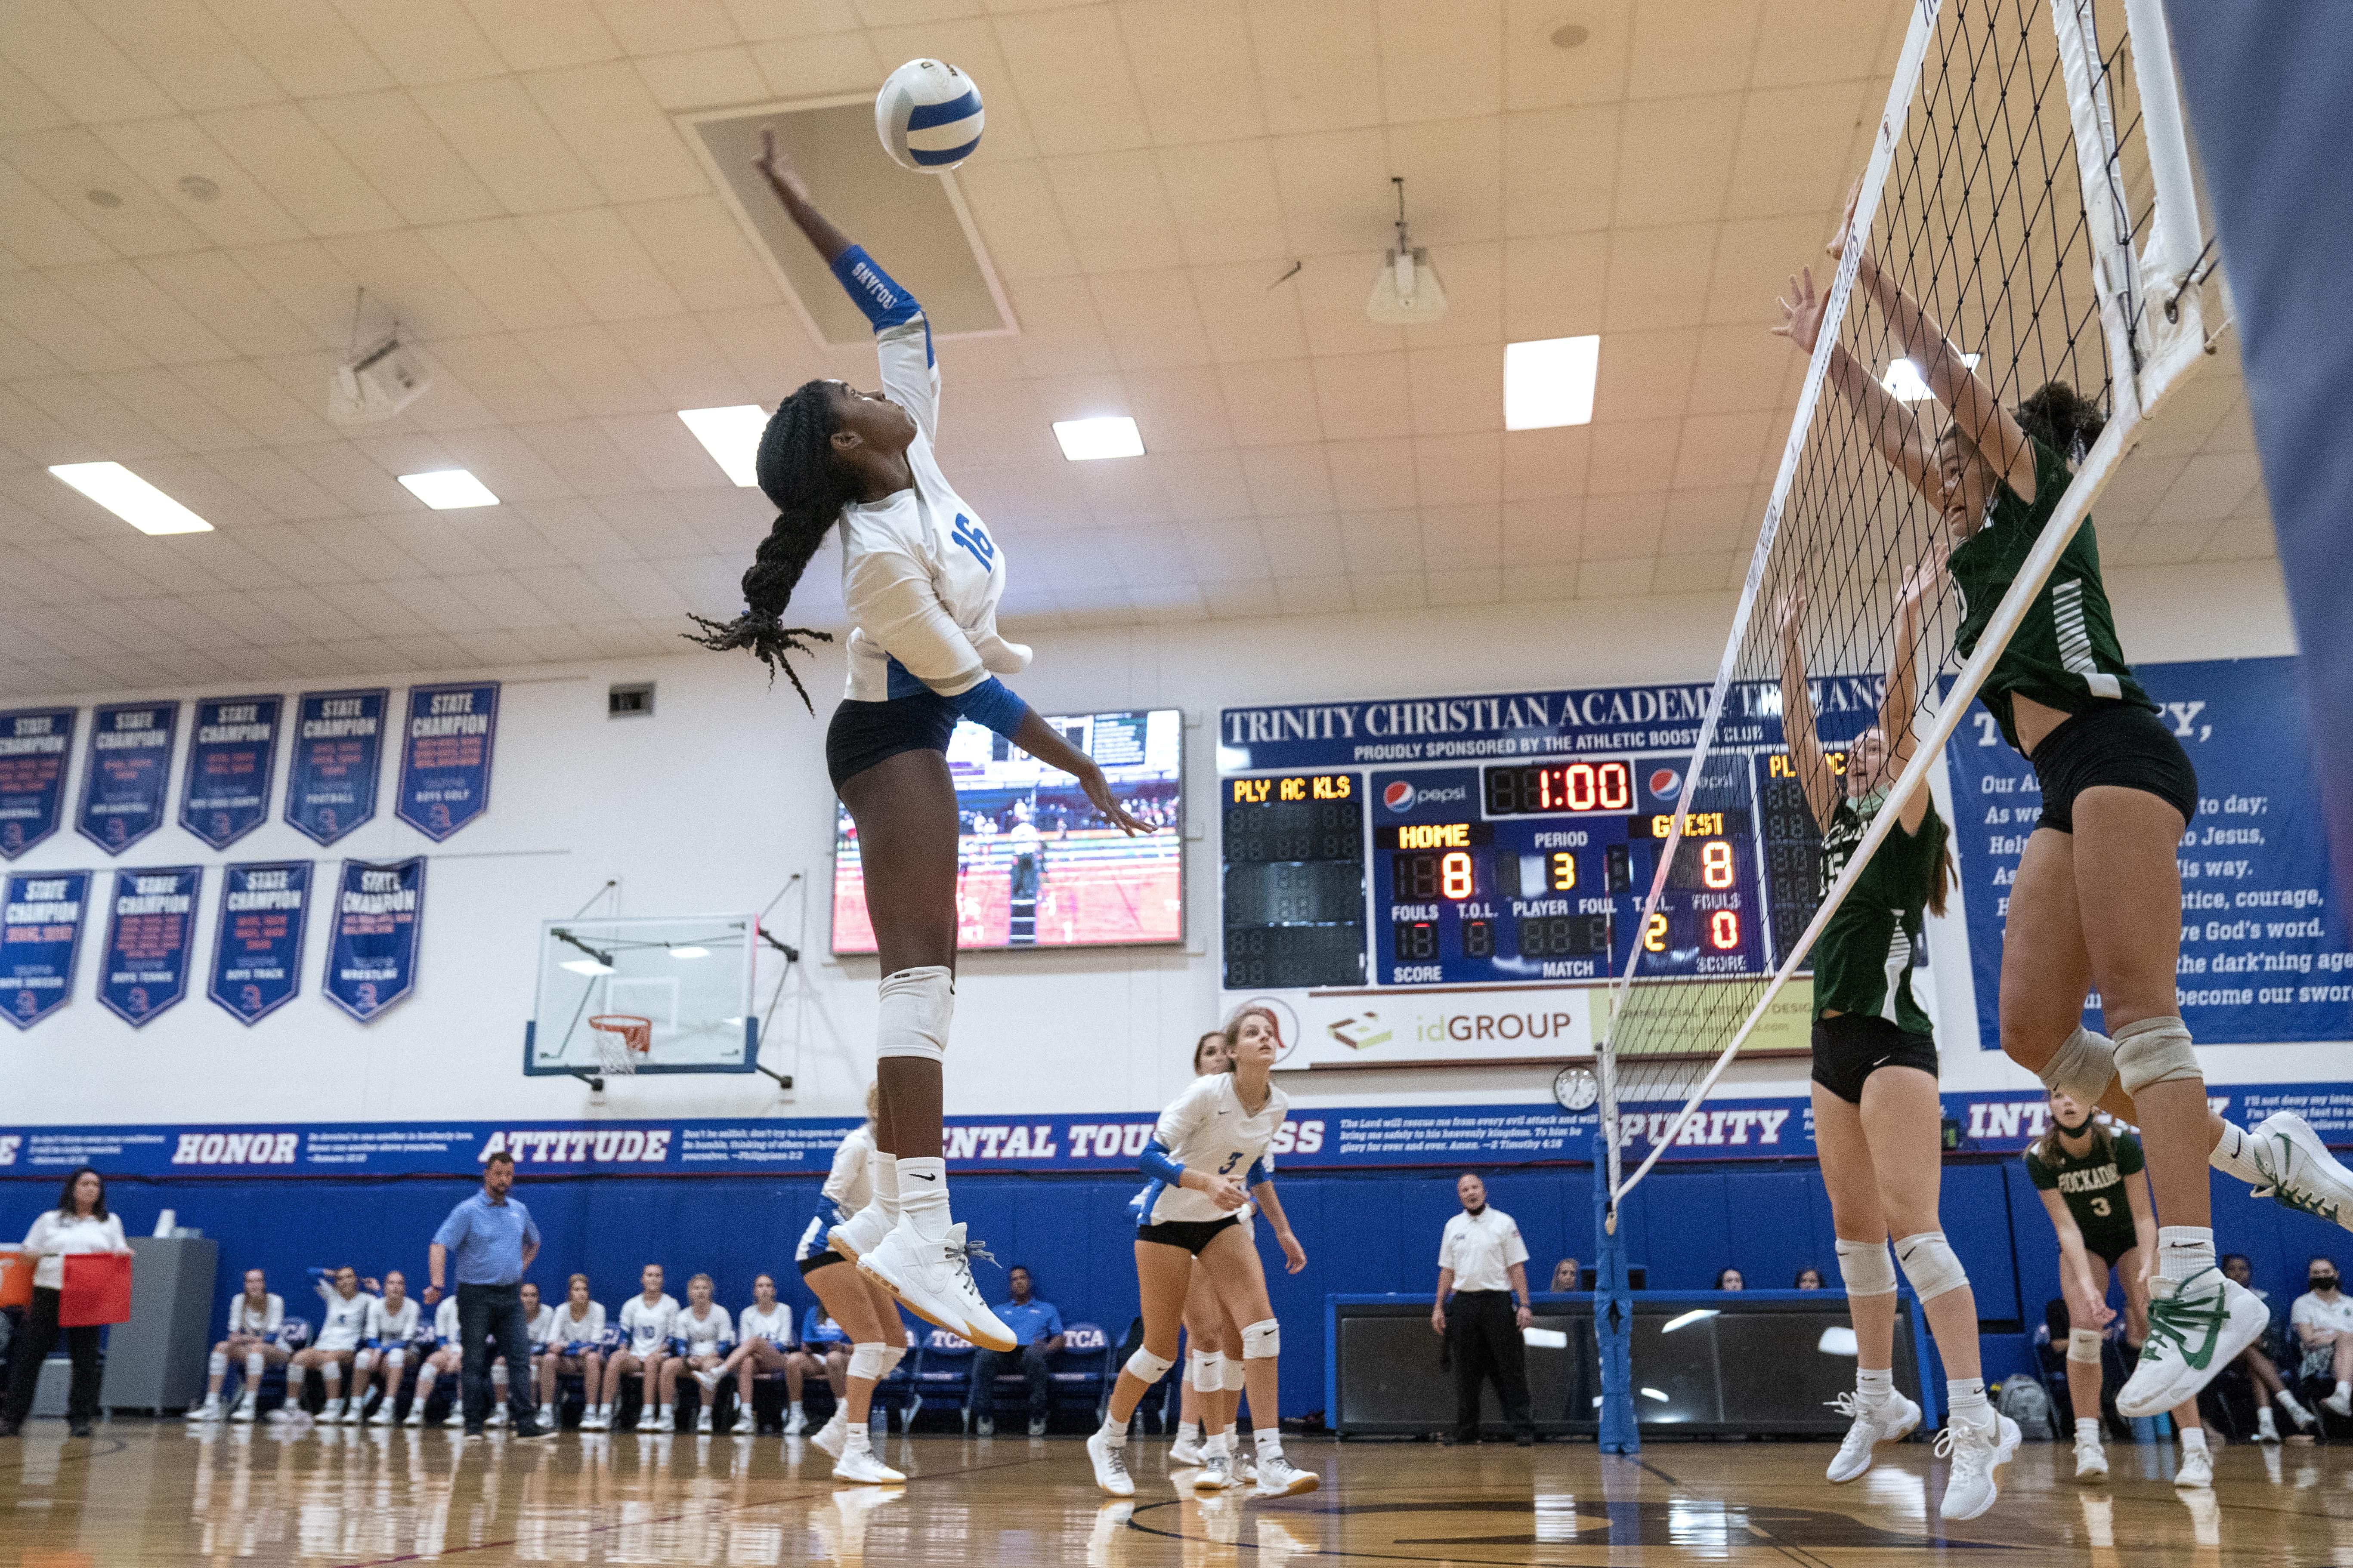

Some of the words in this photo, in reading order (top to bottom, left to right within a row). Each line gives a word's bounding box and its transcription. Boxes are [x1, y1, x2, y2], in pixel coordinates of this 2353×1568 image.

[952, 513, 994, 573] 16
[321, 698, 362, 718] STATE
[430, 693, 473, 714] STATE
[303, 716, 377, 739] CHAMPION
[413, 714, 488, 738] CHAMPION
[1225, 706, 1359, 744] TRINITY
[1365, 696, 1549, 738] CHRISTIAN
[1354, 743, 1422, 762] PROUDLY
[1426, 739, 1515, 758] SPONSORED
[1520, 738, 1539, 753] BY
[1544, 736, 1571, 751] THE
[1576, 732, 1645, 750] ATHLETIC
[1233, 780, 1271, 803] PLY
[1280, 778, 1306, 801] AC
[1313, 775, 1350, 799] KLS
[1417, 785, 1466, 804] pepsi
[1540, 763, 1628, 811] 1:00
[1981, 775, 2017, 793] Our
[1984, 806, 2010, 824] As
[2199, 796, 2220, 815] to
[2224, 794, 2269, 816] day;
[1399, 823, 1471, 849] HOME
[1534, 831, 1589, 848] PERIOD
[2201, 826, 2266, 846] Jesus,
[1442, 851, 1472, 899] 8
[1553, 852, 1576, 891] 3
[1702, 841, 1733, 889] 8
[2205, 859, 2254, 880] way.
[1457, 901, 1499, 919] T.O.L.
[1513, 899, 1568, 917] PLAYER
[1692, 892, 1741, 910] FOULS
[2235, 889, 2324, 909] courage,
[1391, 903, 1439, 921] FOULS
[1644, 913, 1668, 952] 2
[1711, 910, 1738, 949] 0
[2205, 920, 2261, 941] God's
[2266, 917, 2325, 938] word.
[1543, 960, 1594, 978] MATCH
[1696, 955, 1747, 973] SCORE
[2211, 951, 2313, 974] dark'ning
[1393, 965, 1443, 984] SCORE
[2176, 987, 2254, 1007] become
[2258, 988, 2294, 1004] our
[2298, 985, 2353, 1003] swor
[1416, 1012, 1571, 1041] idGROUP
[1618, 1108, 1790, 1146] PURITY
[172, 1133, 299, 1164] HONOR
[478, 1129, 671, 1163] ATTITUDE
[1218, 1151, 1244, 1175] 3
[2090, 1197, 2112, 1217] 3
[1062, 1330, 1105, 1348] TCA
